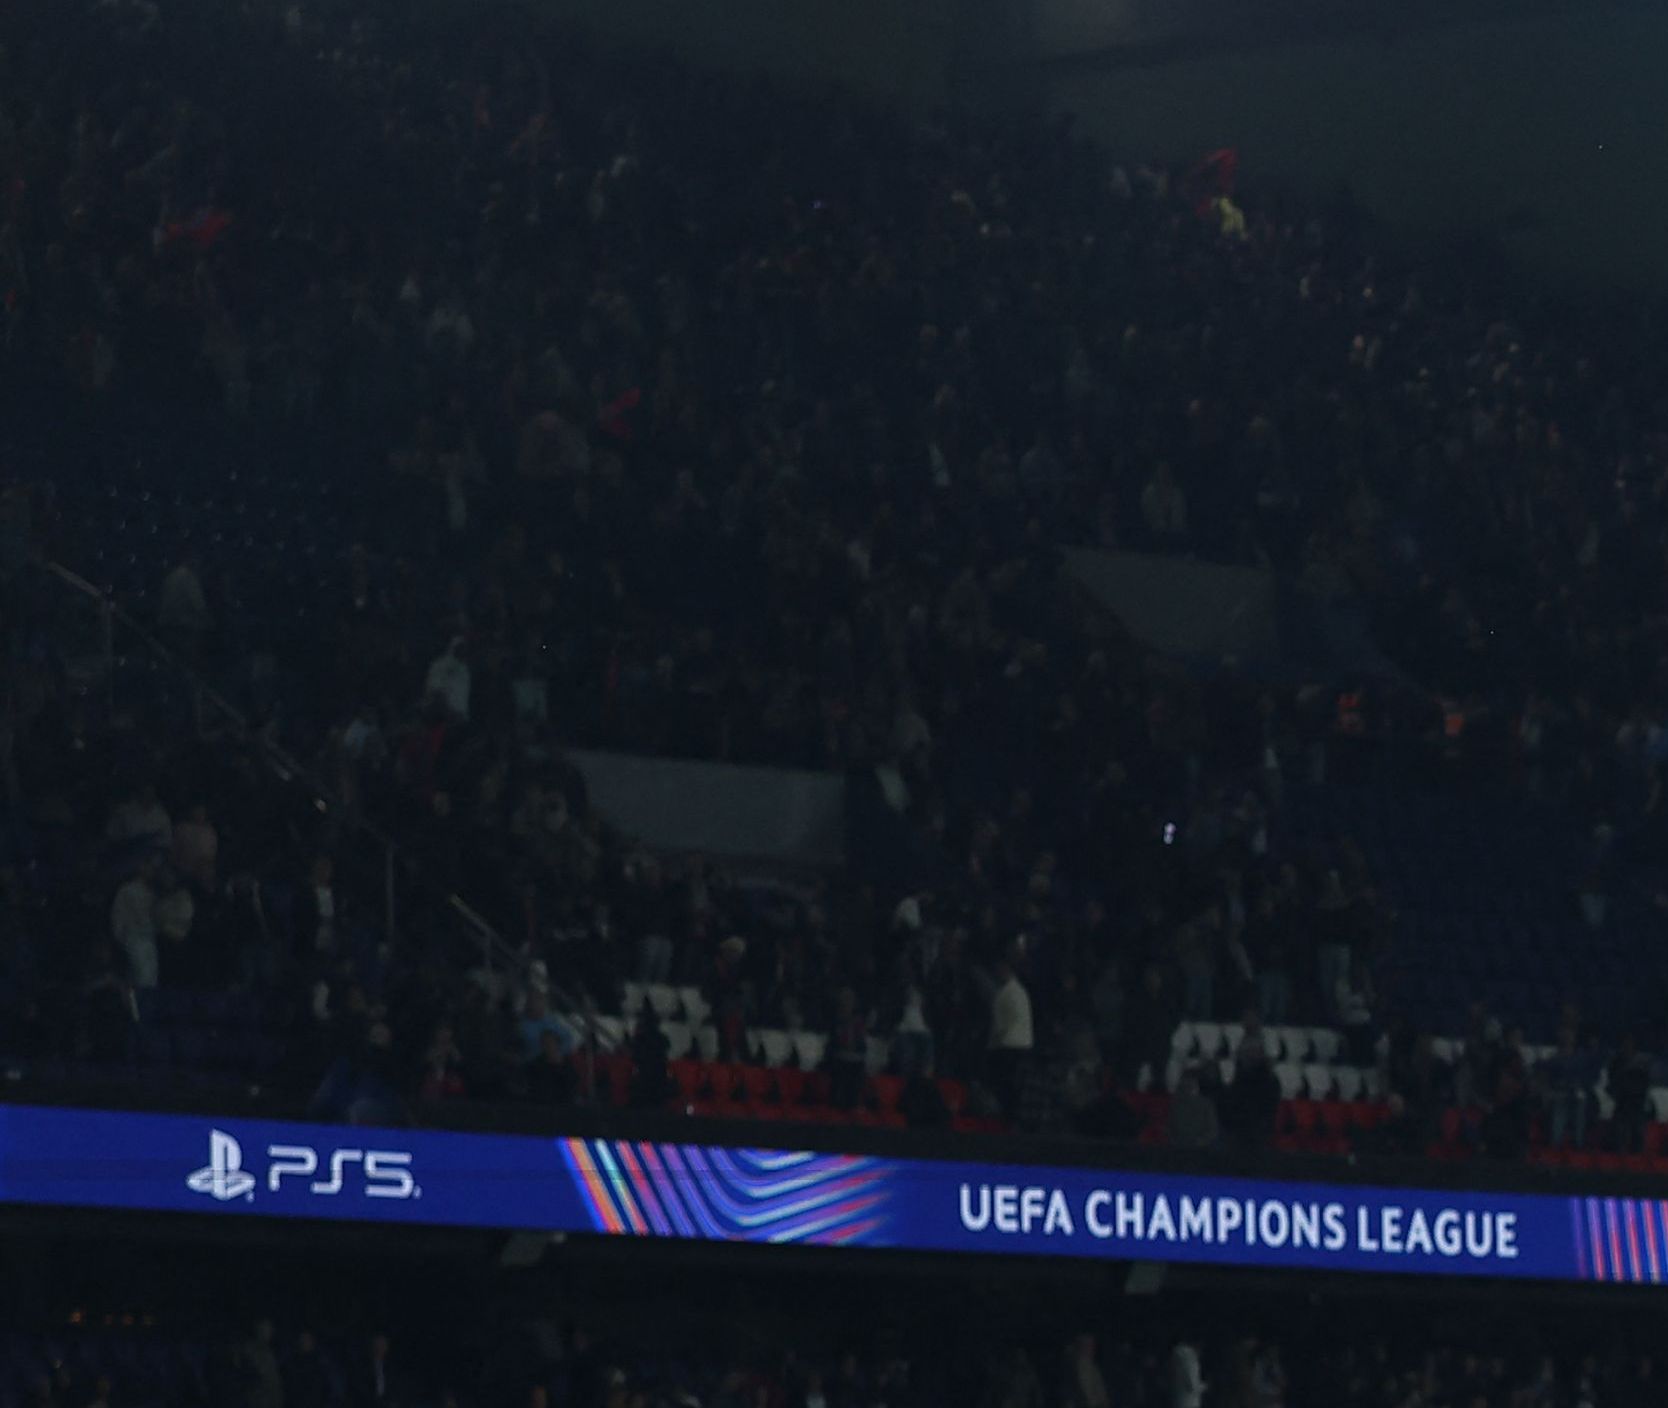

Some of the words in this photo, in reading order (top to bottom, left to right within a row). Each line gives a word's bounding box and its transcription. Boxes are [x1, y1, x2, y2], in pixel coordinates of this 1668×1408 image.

[268, 1145, 414, 1198] PS5
[960, 1183, 1074, 1235] UEFA
[1085, 1190, 1346, 1250] CHAMPIONS
[1358, 1206, 1518, 1258] LEAGUE
